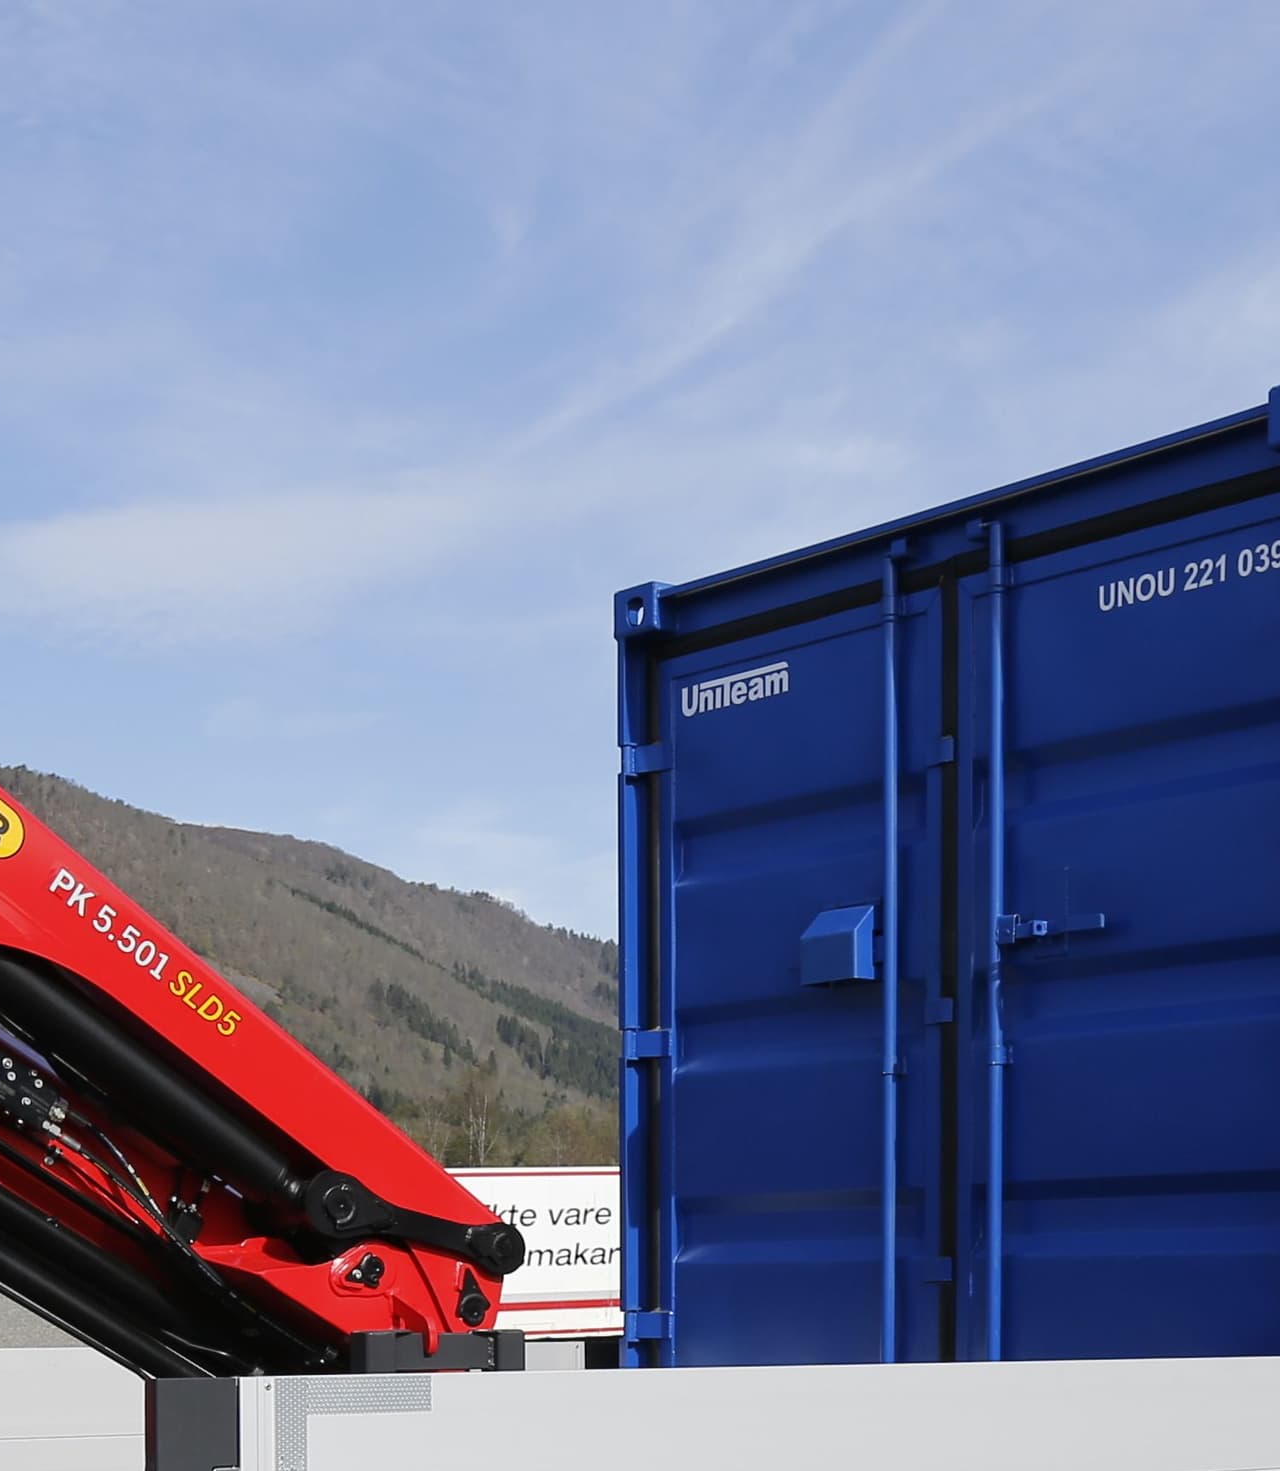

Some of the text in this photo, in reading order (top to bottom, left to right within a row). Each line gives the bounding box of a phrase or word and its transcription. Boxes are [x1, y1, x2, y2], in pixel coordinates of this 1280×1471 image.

[1098, 566, 1176, 612] UNOU
[1182, 553, 1228, 592] 221
[680, 660, 790, 718] UniTeam
[49, 866, 243, 1038] PK 5.501 SLD5
[548, 1206, 612, 1227] vare
